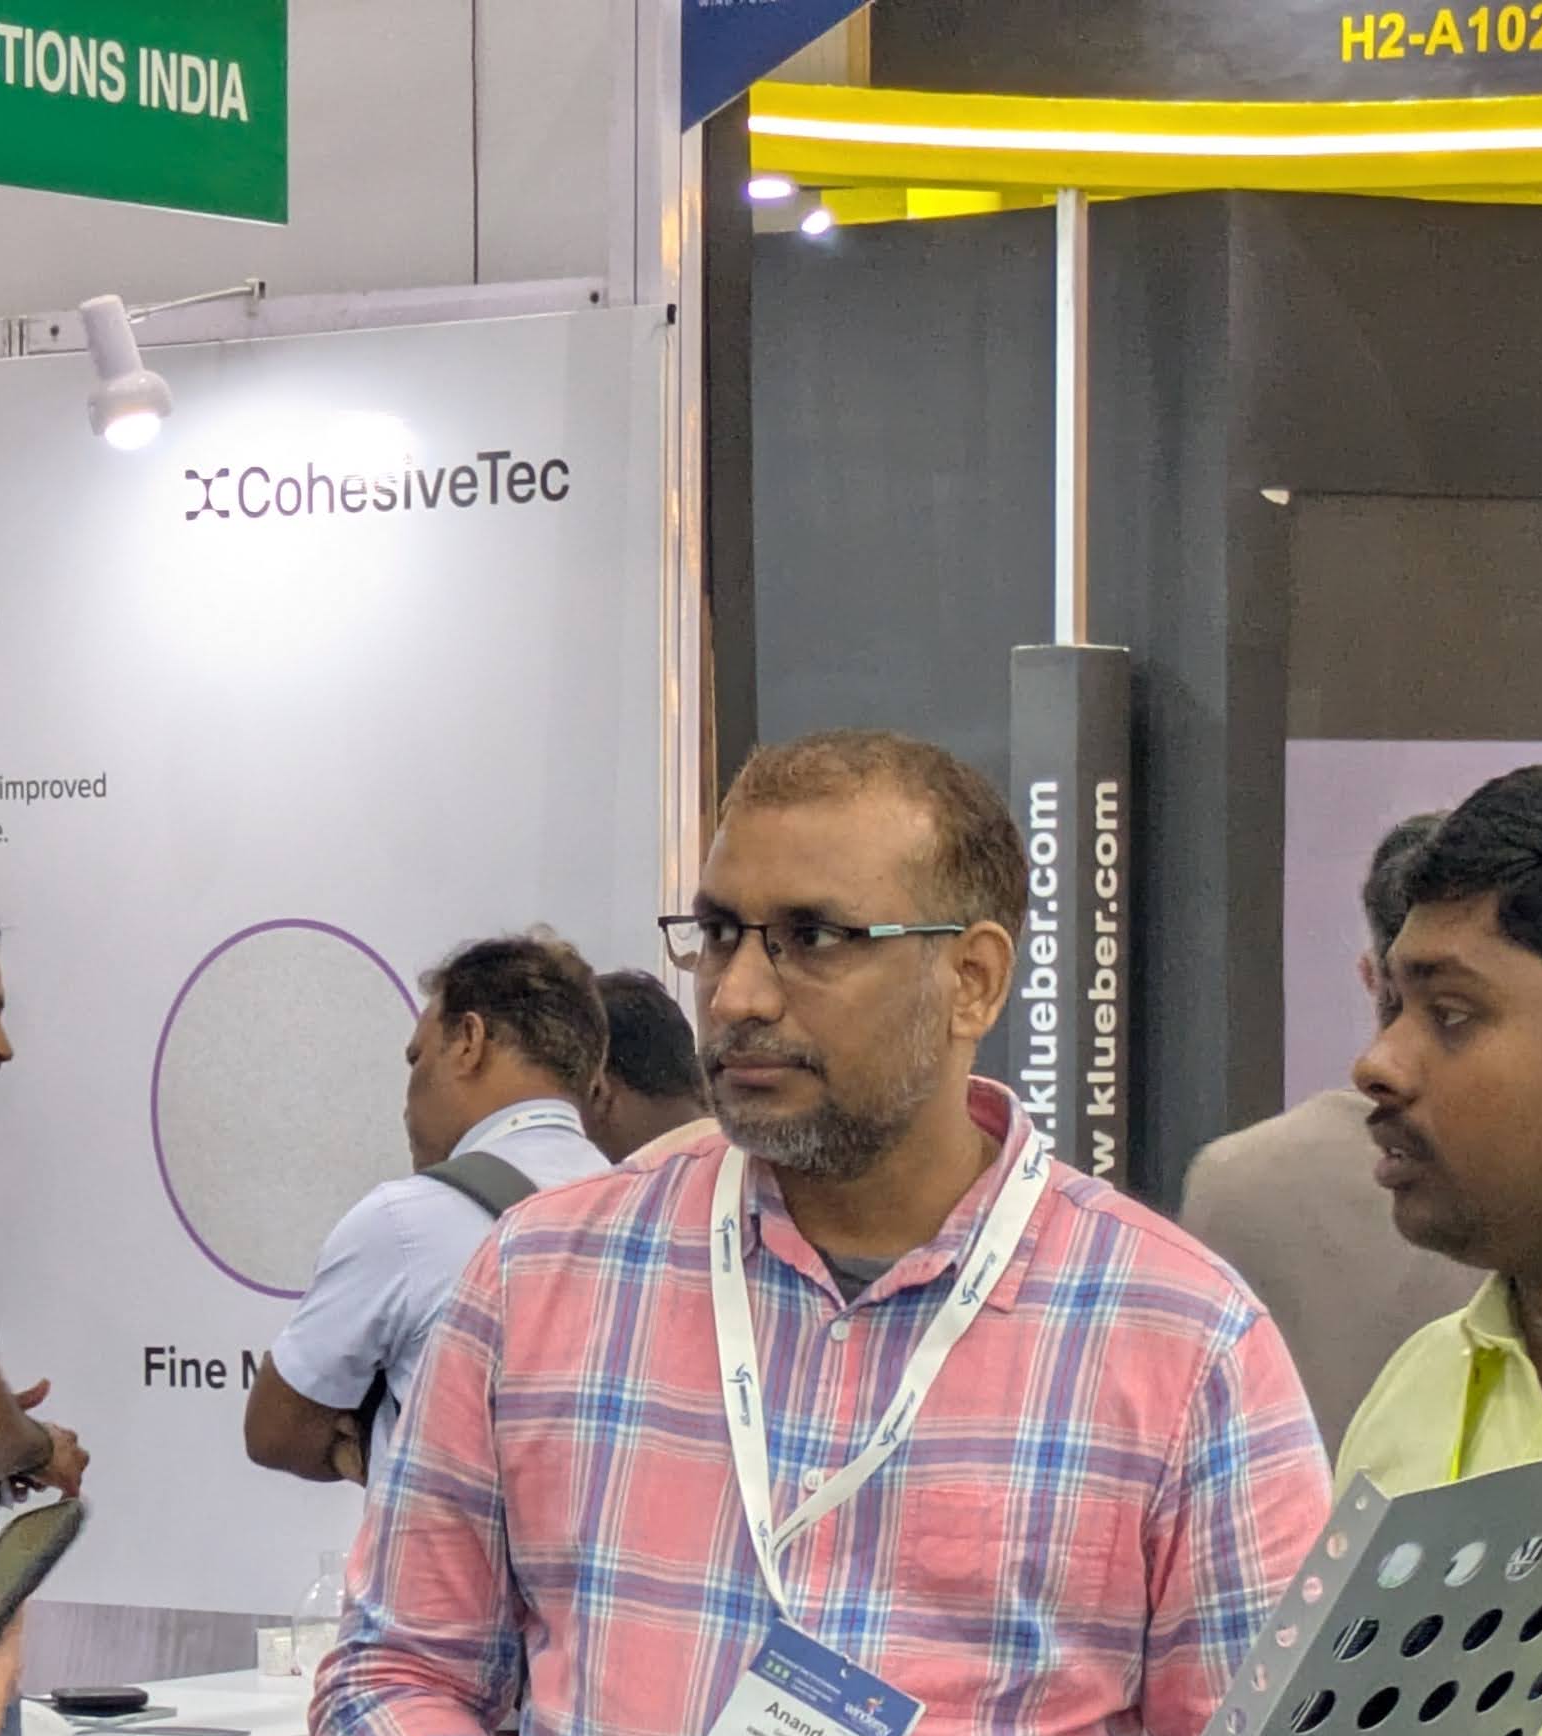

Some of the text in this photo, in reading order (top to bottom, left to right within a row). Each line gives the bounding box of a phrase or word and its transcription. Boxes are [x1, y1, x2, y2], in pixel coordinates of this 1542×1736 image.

[138, 47, 248, 122] INDIA
[238, 450, 570, 518] CohesiveTec
[1087, 781, 1118, 1117] klueber.com
[144, 1346, 227, 1390] Fine
